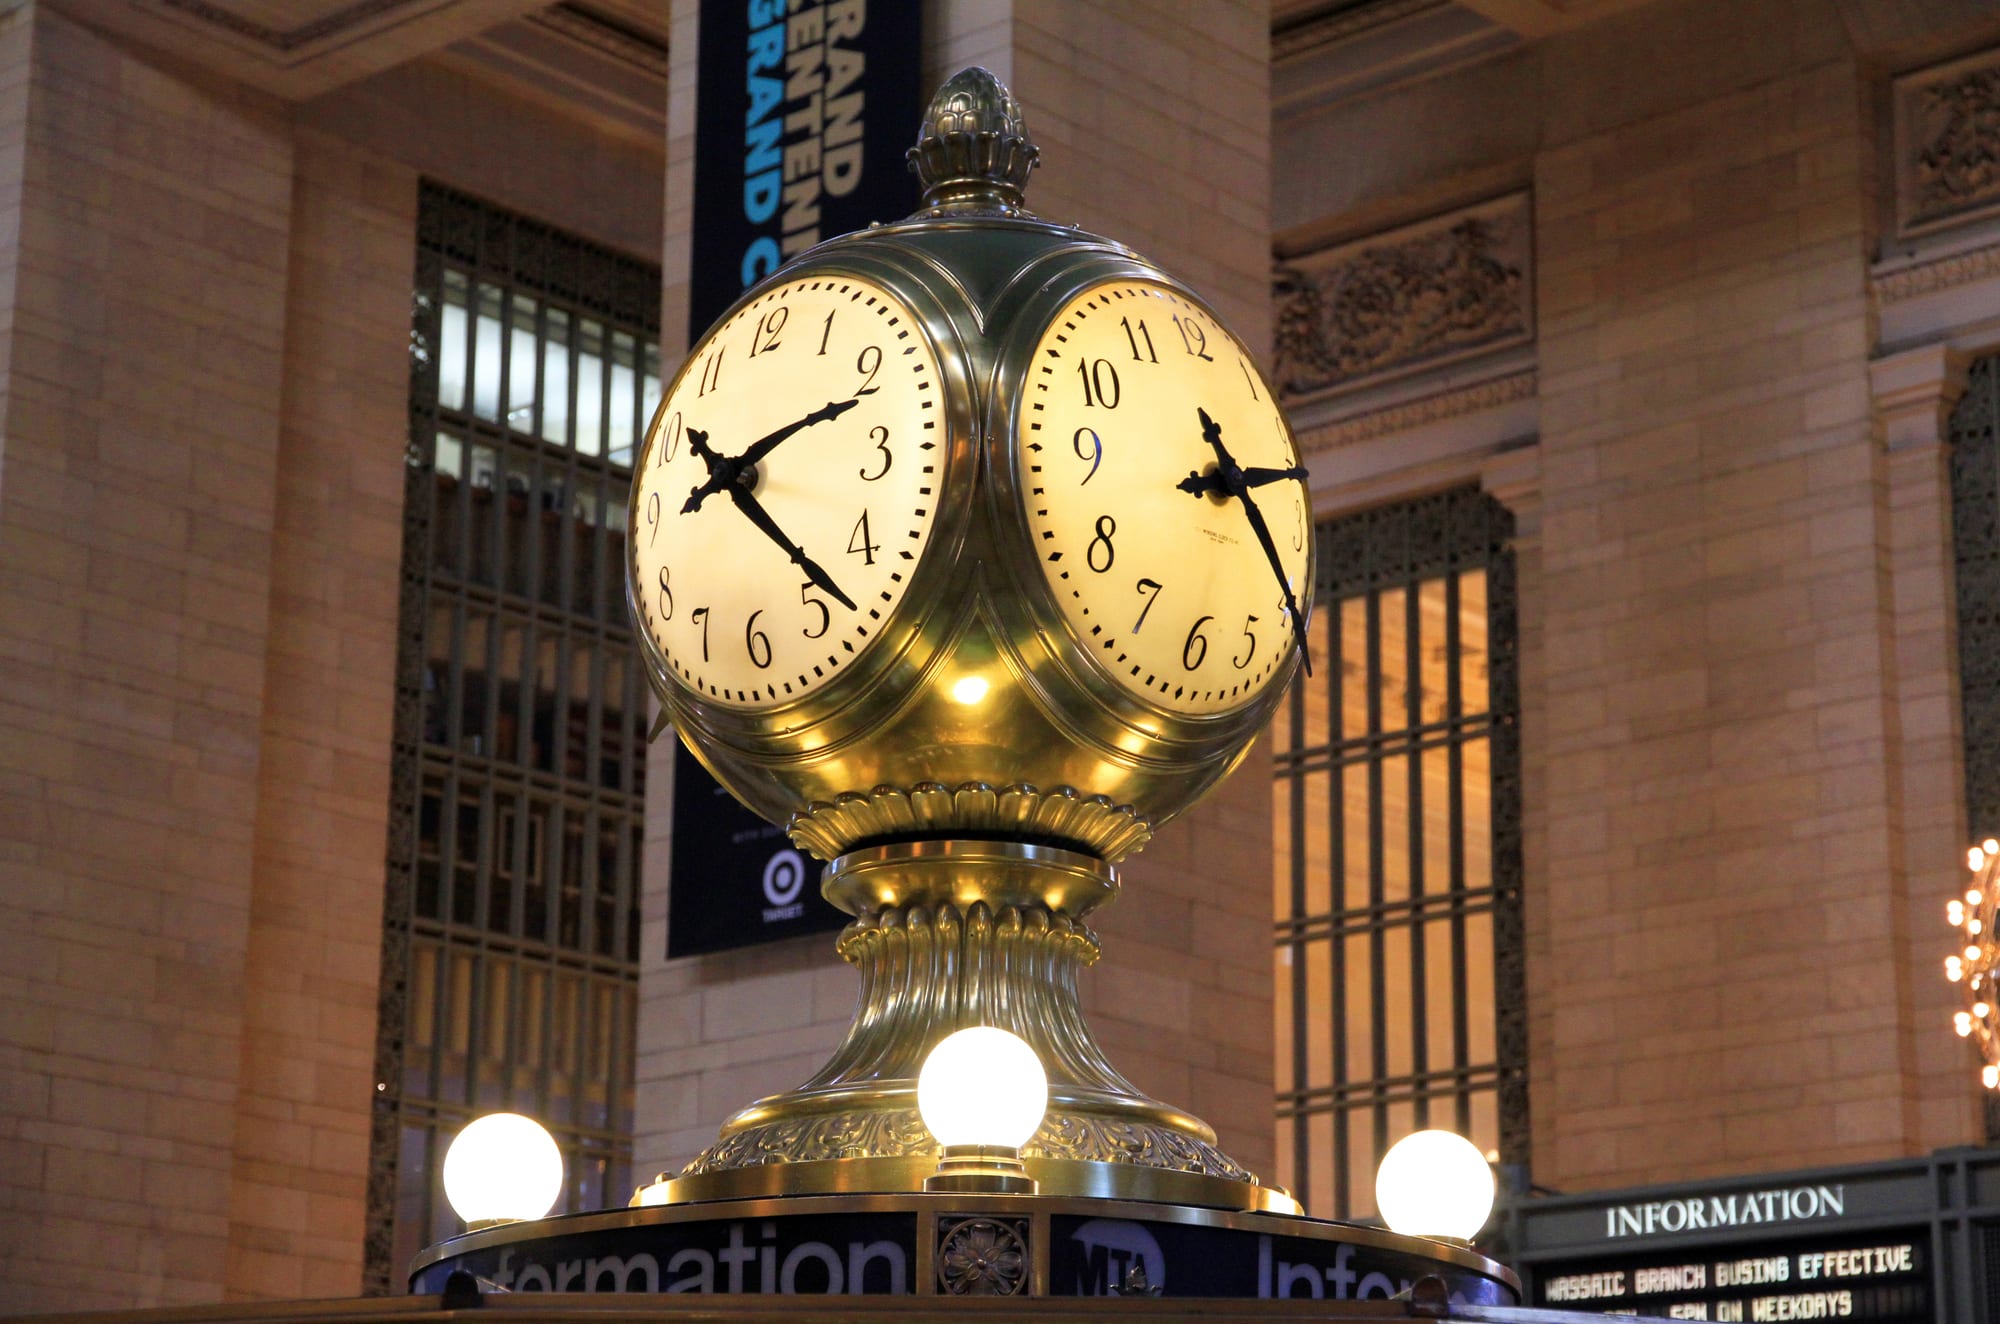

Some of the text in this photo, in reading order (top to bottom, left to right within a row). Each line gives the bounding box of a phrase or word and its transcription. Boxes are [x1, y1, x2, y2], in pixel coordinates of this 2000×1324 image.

[749, 306, 789, 358] 12
[816, 308, 837, 356] 1
[1120, 315, 1161, 364] 11
[1172, 312, 1214, 363] 12
[697, 345, 726, 399] 11
[853, 345, 883, 398] 2
[1077, 356, 1121, 410] 10
[1237, 357, 1260, 402] 1
[656, 411, 683, 469] 10
[859, 426, 893, 482] 3
[1073, 427, 1103, 487] 9
[647, 491, 661, 549] 9
[846, 507, 881, 566] 4
[1086, 514, 1117, 574] 8
[1292, 498, 1304, 553] 3
[658, 565, 674, 621] 8
[800, 578, 831, 639] 5
[1131, 577, 1164, 635] 7
[691, 606, 710, 663] 7
[745, 609, 773, 670] 6
[1182, 615, 1215, 672] 6
[1232, 614, 1260, 670] 5
[1606, 1184, 1845, 1238] INFORMATION
[455, 1223, 907, 1294] formation
[1634, 1263, 1707, 1295] BRANCH
[1799, 1244, 1913, 1280] EFFECTIVE
[1716, 1299, 1743, 1323] ON
[1752, 1290, 1853, 1323] WEEKDAYS
